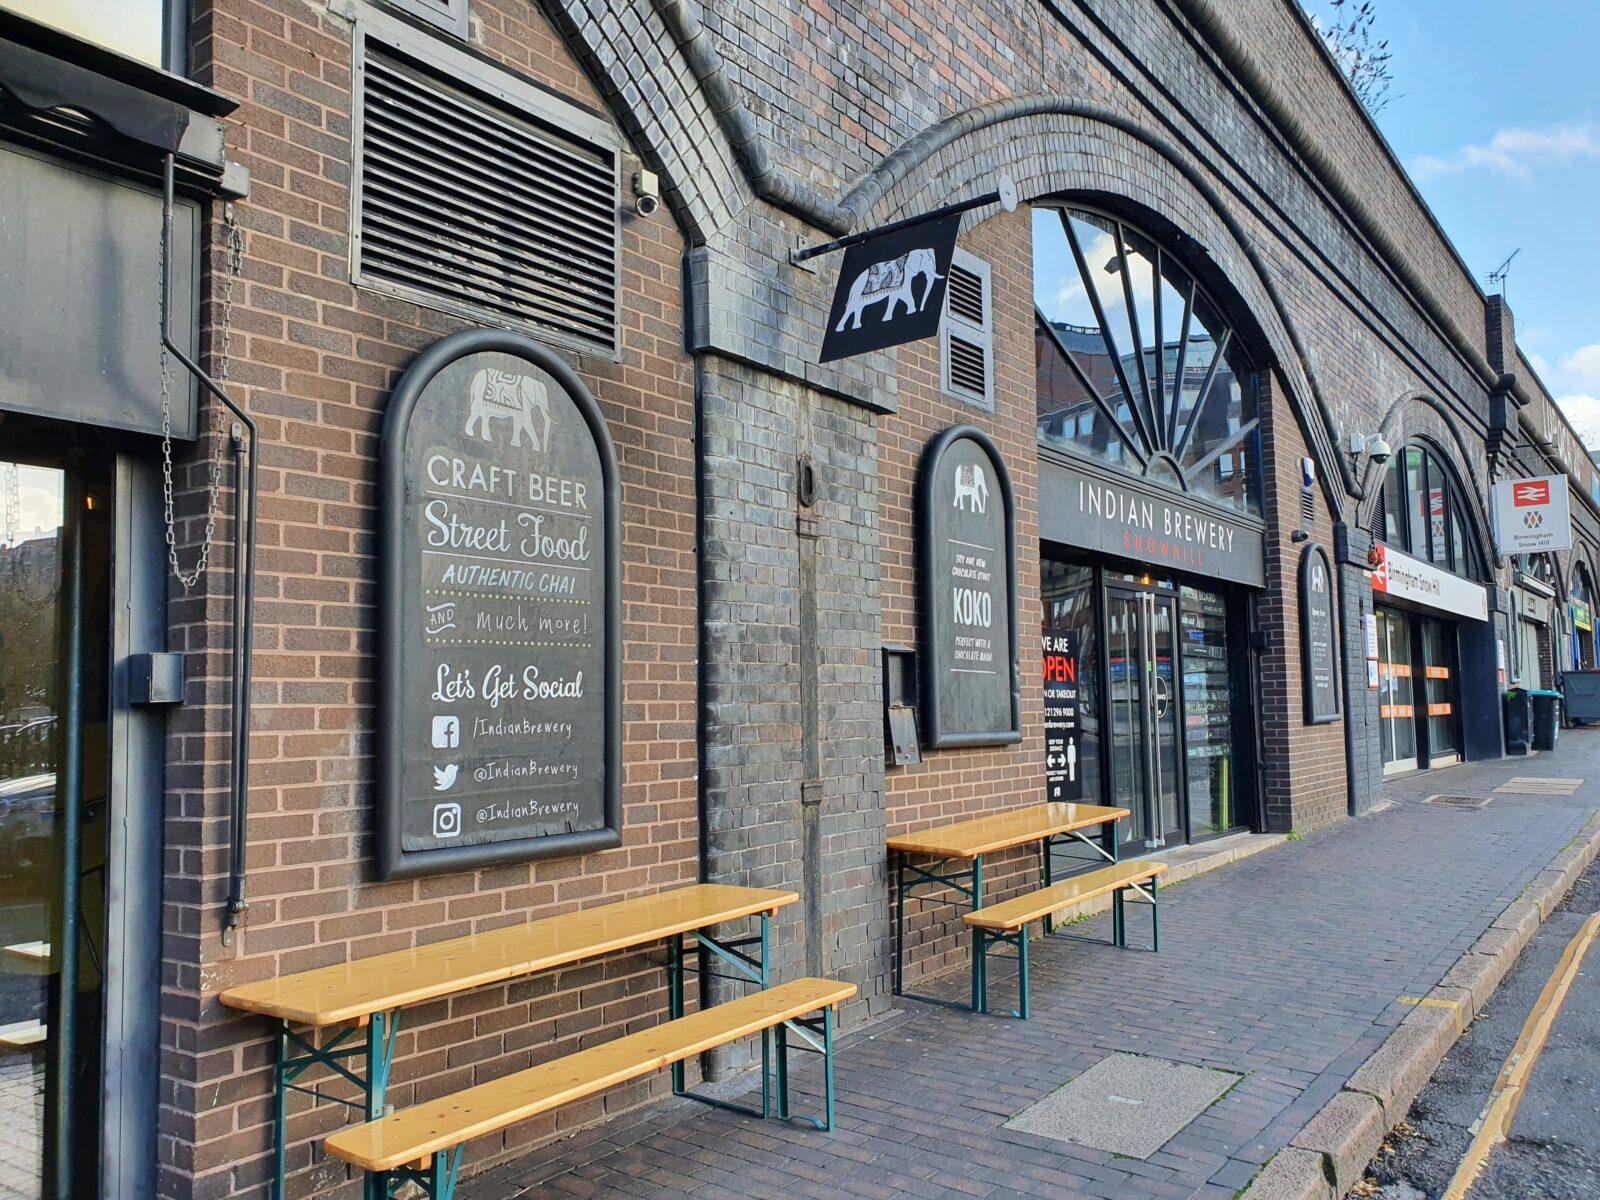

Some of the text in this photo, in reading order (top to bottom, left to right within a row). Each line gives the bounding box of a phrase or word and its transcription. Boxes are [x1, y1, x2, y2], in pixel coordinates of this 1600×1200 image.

[427, 454, 588, 510] CRAFT BEER
[1079, 481, 1234, 553] INDIAN BREWERY
[425, 500, 590, 561] Street Food
[1513, 532, 1554, 541] Birmingham
[1123, 530, 1204, 566] SNOWHILL
[952, 566, 977, 580] CHOCOLATE
[976, 558, 986, 568] NEW
[441, 564, 576, 595] AUTHENTIC CHAI
[1388, 560, 1441, 597] Birmingham Snow Hill
[429, 608, 454, 626] AND
[953, 587, 992, 628] KOKO
[539, 610, 588, 634] more!
[955, 636, 974, 647] PERFECT
[975, 638, 987, 649] WITH
[1053, 637, 1069, 653] ARE
[954, 649, 979, 661] CHOCOLATE
[431, 663, 584, 709] Let's Get Social
[1047, 689, 1056, 699] OR
[1056, 689, 1077, 699] TAKEOUT
[1053, 707, 1062, 717] 296
[1062, 707, 1074, 717] 9000
[472, 716, 572, 739] /IndianBrewery
[474, 758, 578, 782] @IndianBrewery
[476, 798, 579, 823] @IndianBrewery
